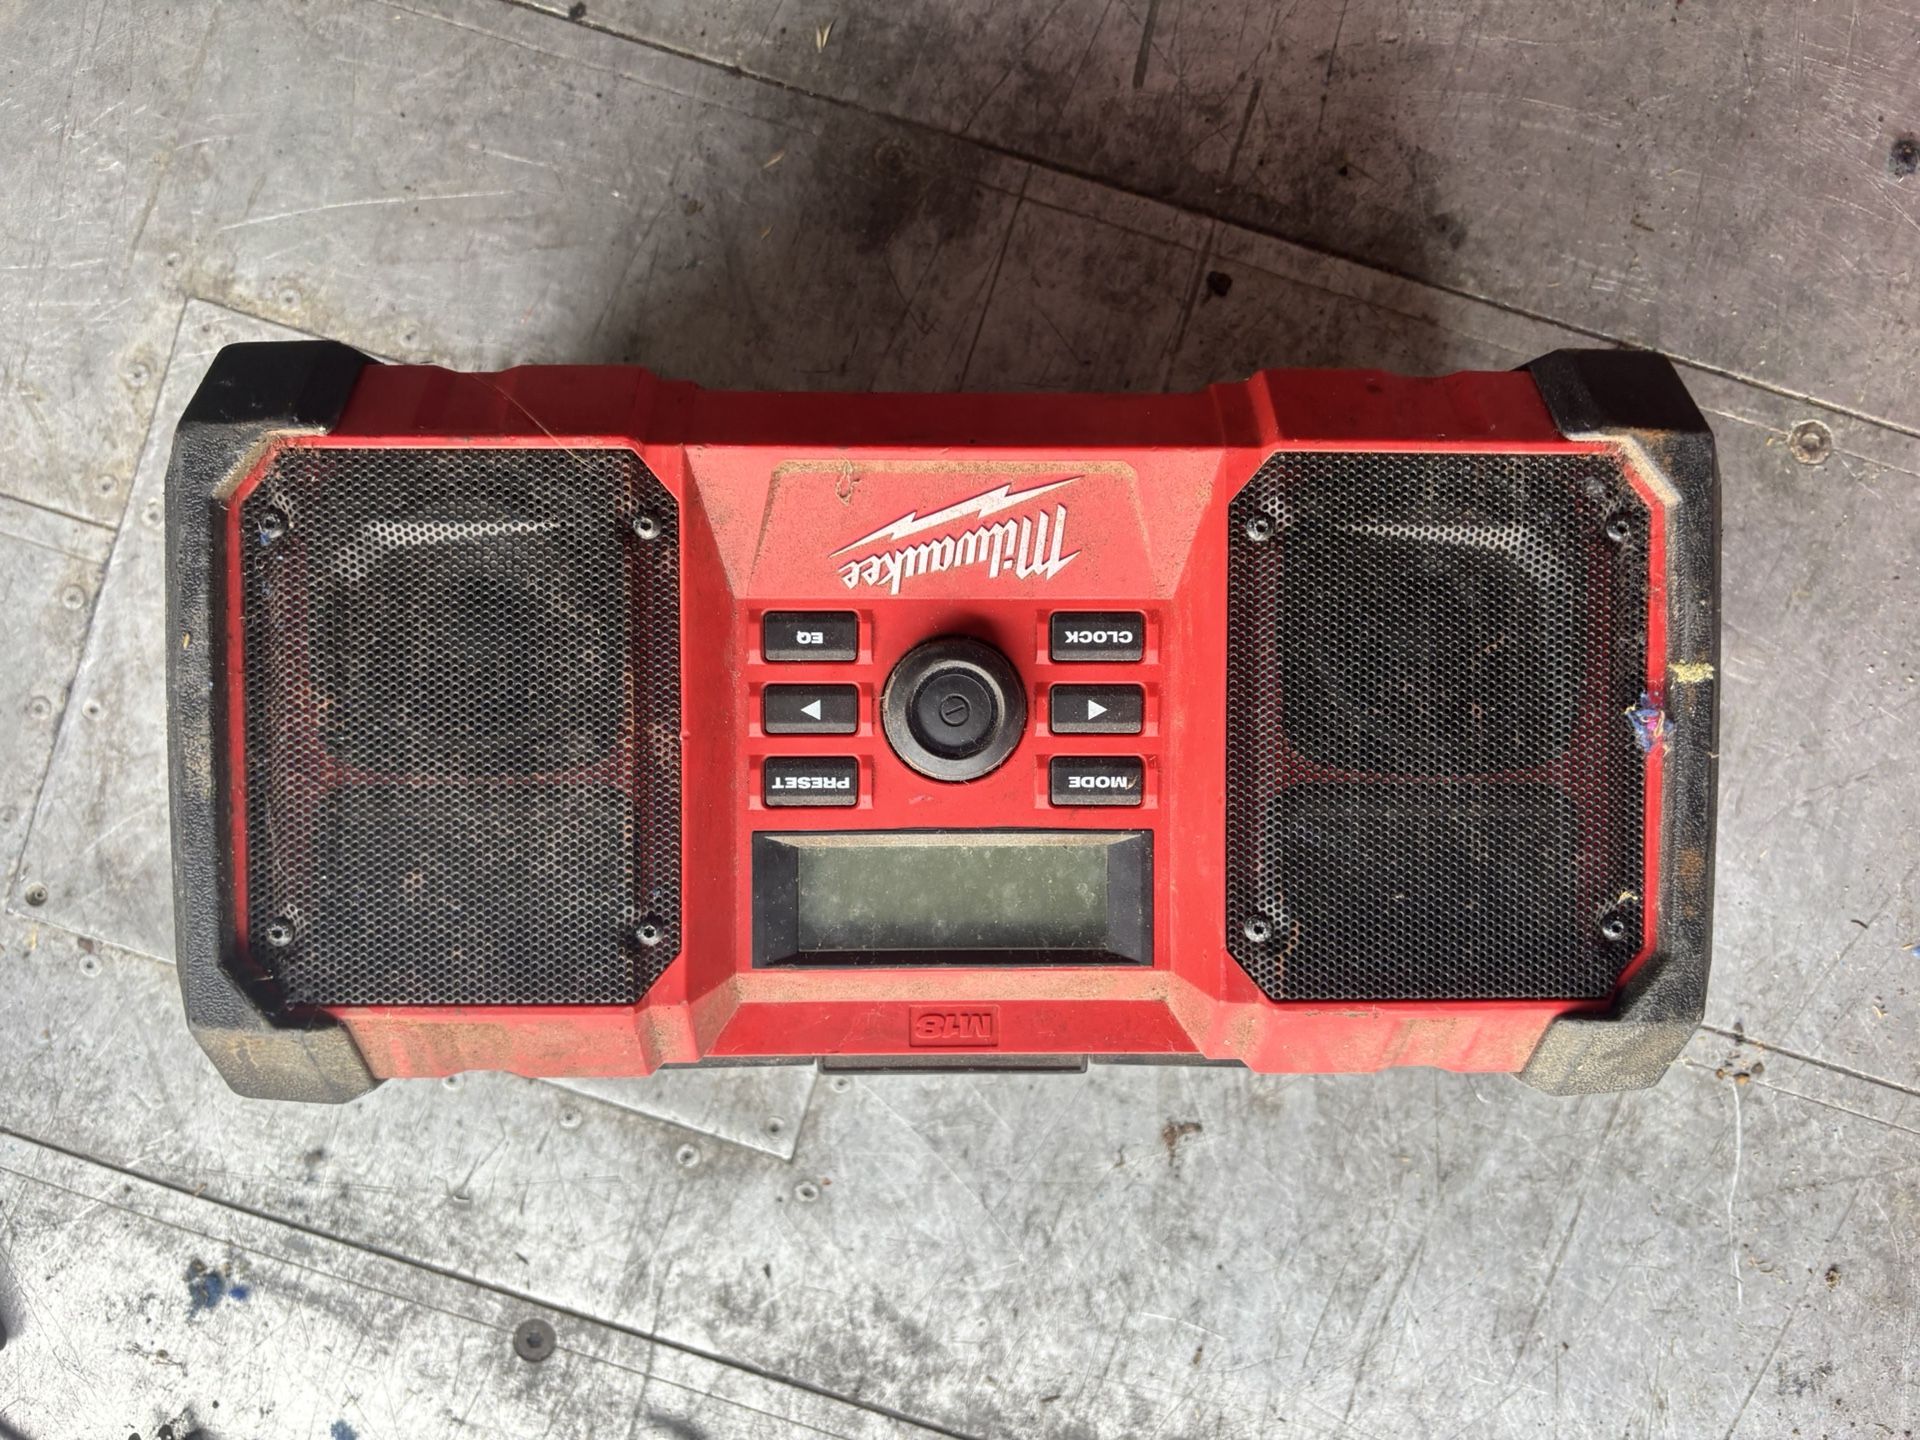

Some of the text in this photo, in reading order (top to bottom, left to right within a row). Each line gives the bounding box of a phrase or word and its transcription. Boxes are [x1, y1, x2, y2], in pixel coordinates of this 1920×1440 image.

[837, 503, 1081, 596] Milwaukee
[796, 631, 824, 645] EQ
[1064, 630, 1133, 644] CLOCK
[771, 776, 850, 790] PRESET
[1068, 776, 1128, 789] MODE
[915, 1013, 992, 1039] M18
